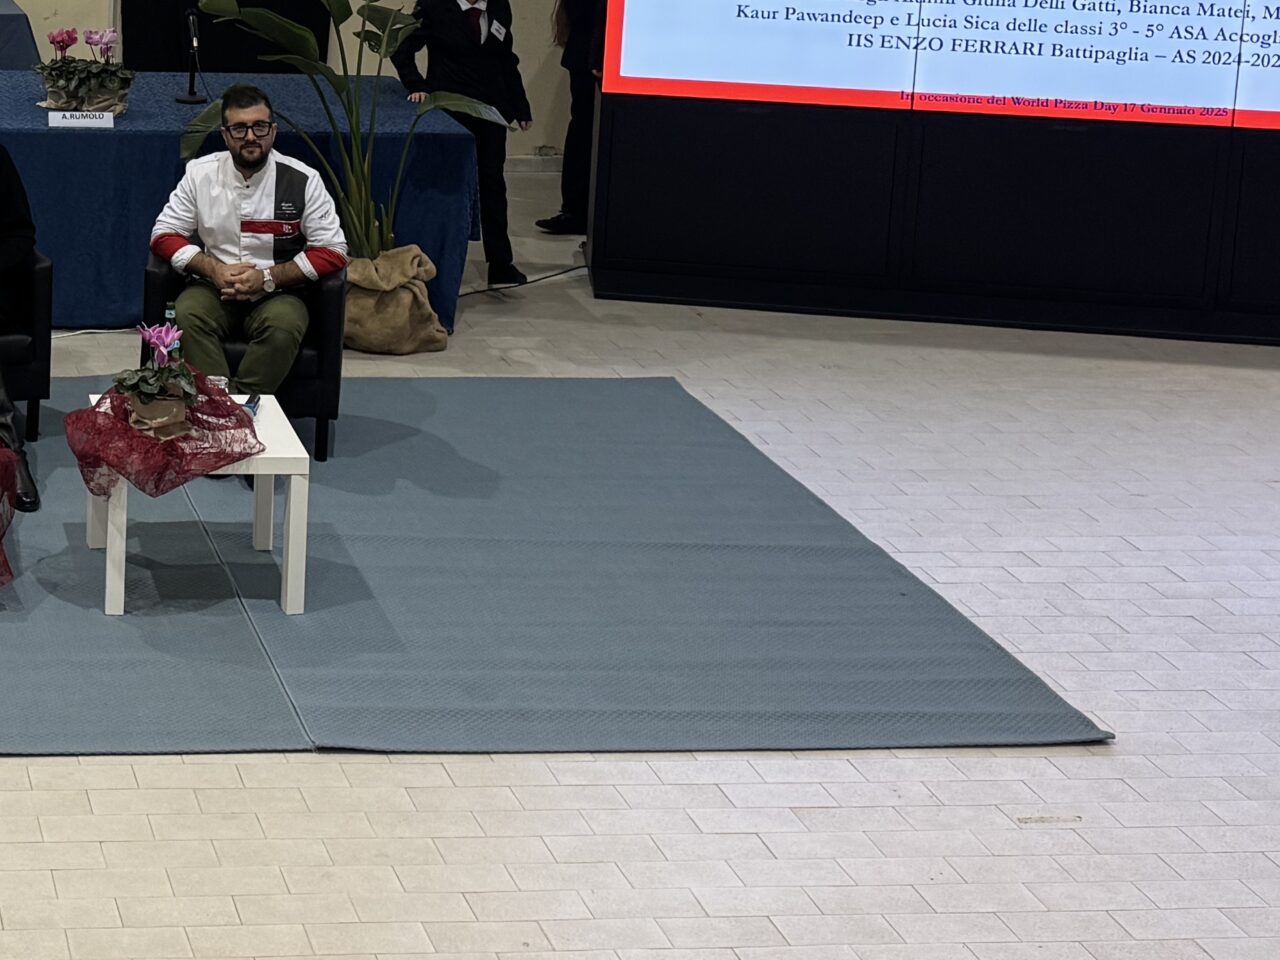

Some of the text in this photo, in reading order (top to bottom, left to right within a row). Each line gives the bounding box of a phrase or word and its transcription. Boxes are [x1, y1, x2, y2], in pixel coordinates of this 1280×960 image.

[735, 4, 780, 20] Kaur
[784, 6, 885, 30] Pawandeep
[890, 14, 900, 27] e
[906, 12, 958, 30] Lucia
[963, 14, 1000, 31] Sica
[1006, 16, 1049, 34] delle
[1054, 19, 1103, 37] classi
[1169, 25, 1208, 41] ASA
[1214, 26, 1280, 49] Accogl
[1196, 2, 1256, 23] Matei,
[847, 33, 874, 49] IIS
[879, 34, 945, 52] ENZO
[950, 38, 1045, 57] FERRARI
[1051, 42, 1149, 66] Battipaglia
[1172, 48, 1197, 65] AS
[919, 93, 983, 105] occasione
[986, 95, 1007, 107] del
[1011, 96, 1050, 108] World
[1053, 98, 1088, 110] Pizza
[1093, 100, 1119, 114] Day
[1122, 102, 1138, 113] 17
[1140, 103, 1196, 116] Gennaio
[1199, 106, 1229, 117] 2025
